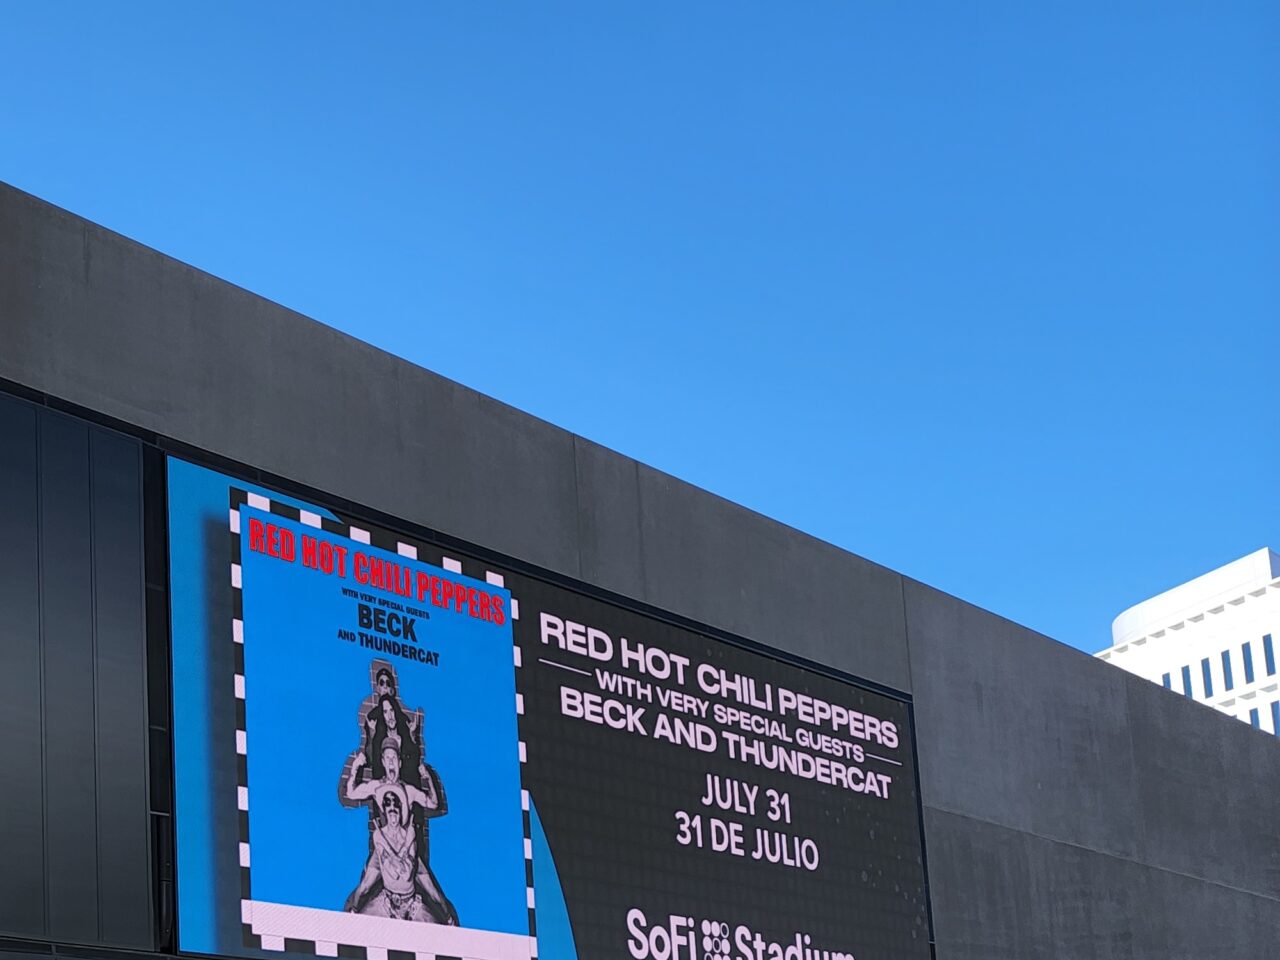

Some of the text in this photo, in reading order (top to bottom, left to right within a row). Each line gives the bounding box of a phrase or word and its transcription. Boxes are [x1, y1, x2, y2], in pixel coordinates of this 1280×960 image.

[249, 518, 506, 626] RED HOT CHILI PEPPERS
[337, 629, 440, 667] AND THUNDERCAT
[357, 603, 418, 643] BECK
[539, 612, 899, 749] RED HOT CHILI PEPPERS
[595, 668, 865, 763] WITH VERY SPECIAL GUESTS
[560, 685, 892, 799] BECK AND THUNDERCAT
[701, 773, 791, 824] JULY 31
[674, 810, 819, 871] 31 DE JULIO
